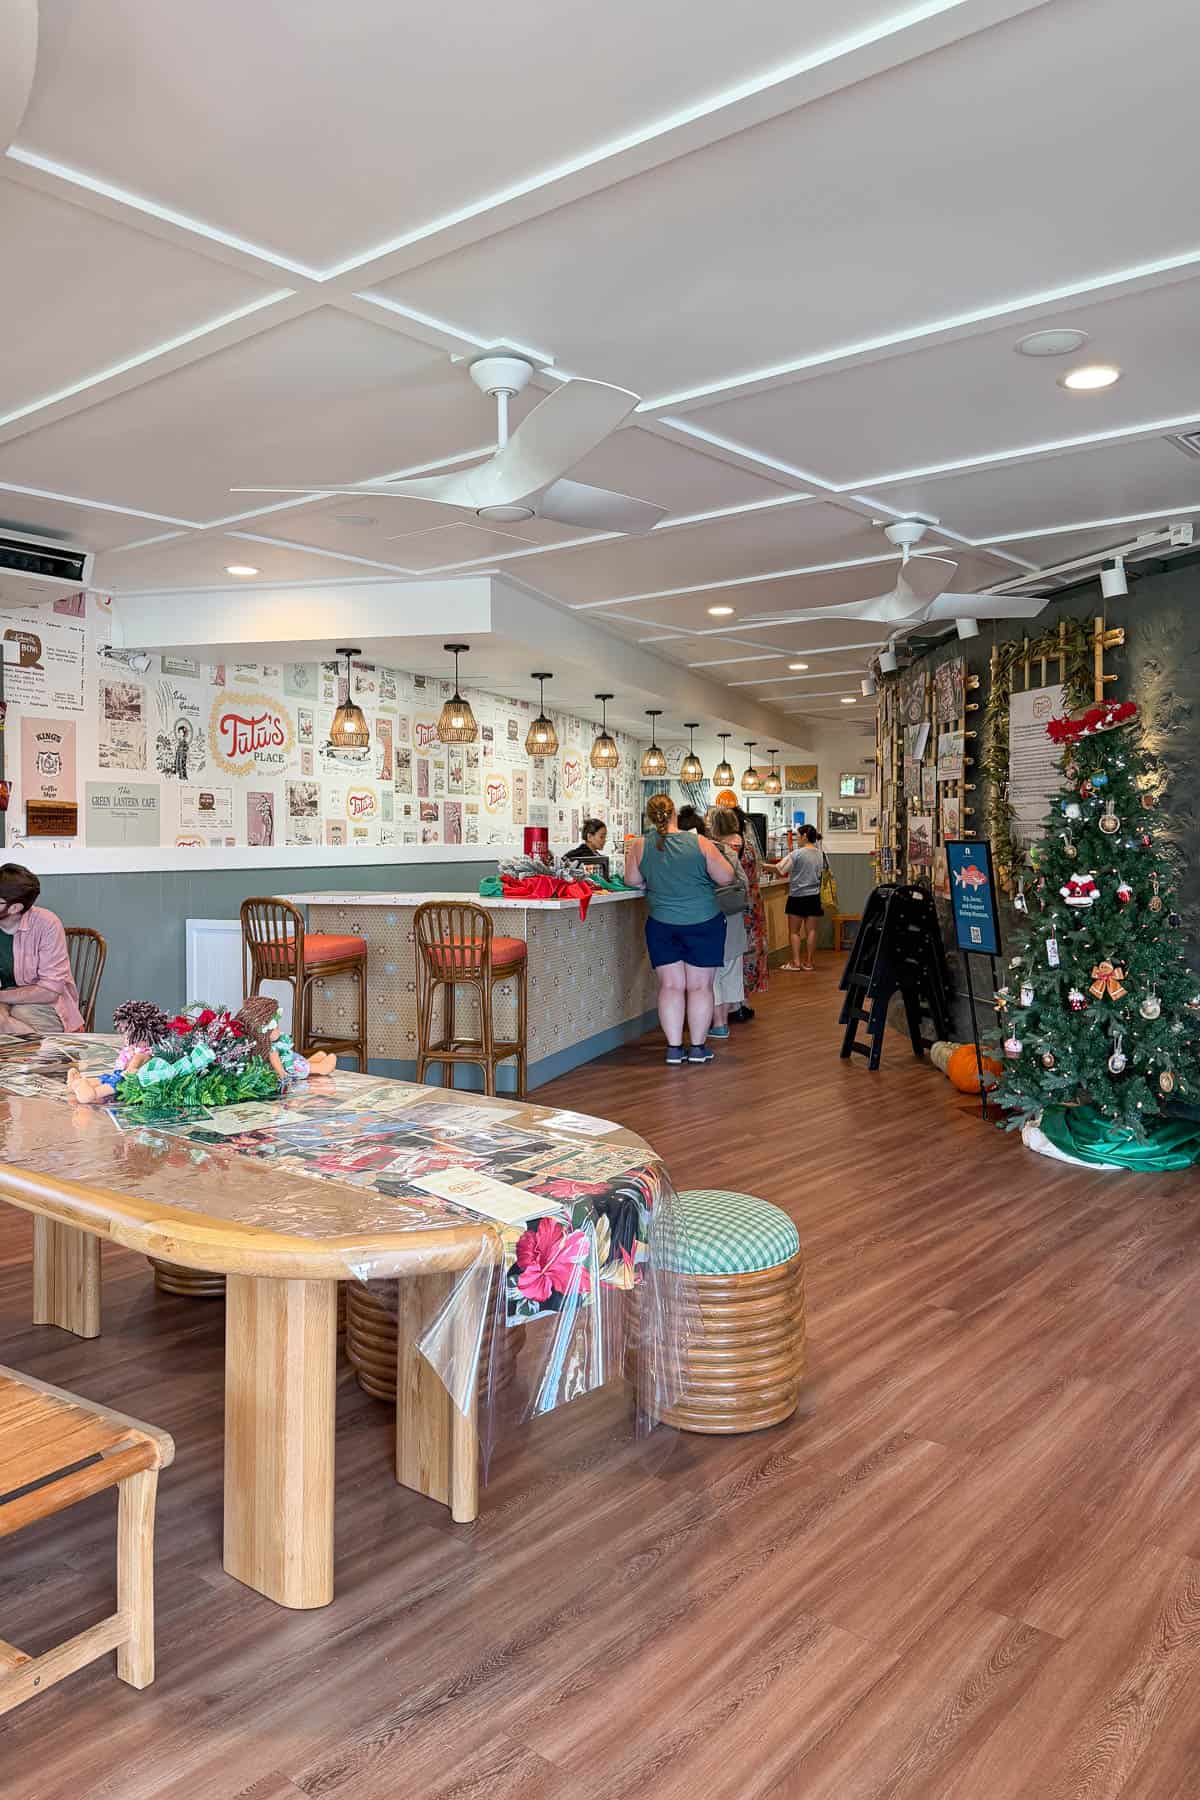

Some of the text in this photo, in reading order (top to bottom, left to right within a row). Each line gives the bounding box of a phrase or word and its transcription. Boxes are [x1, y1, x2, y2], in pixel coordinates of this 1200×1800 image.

[253, 752, 285, 764] PLACE
[91, 796, 111, 806] GREEN
[113, 796, 139, 807] LANTERN
